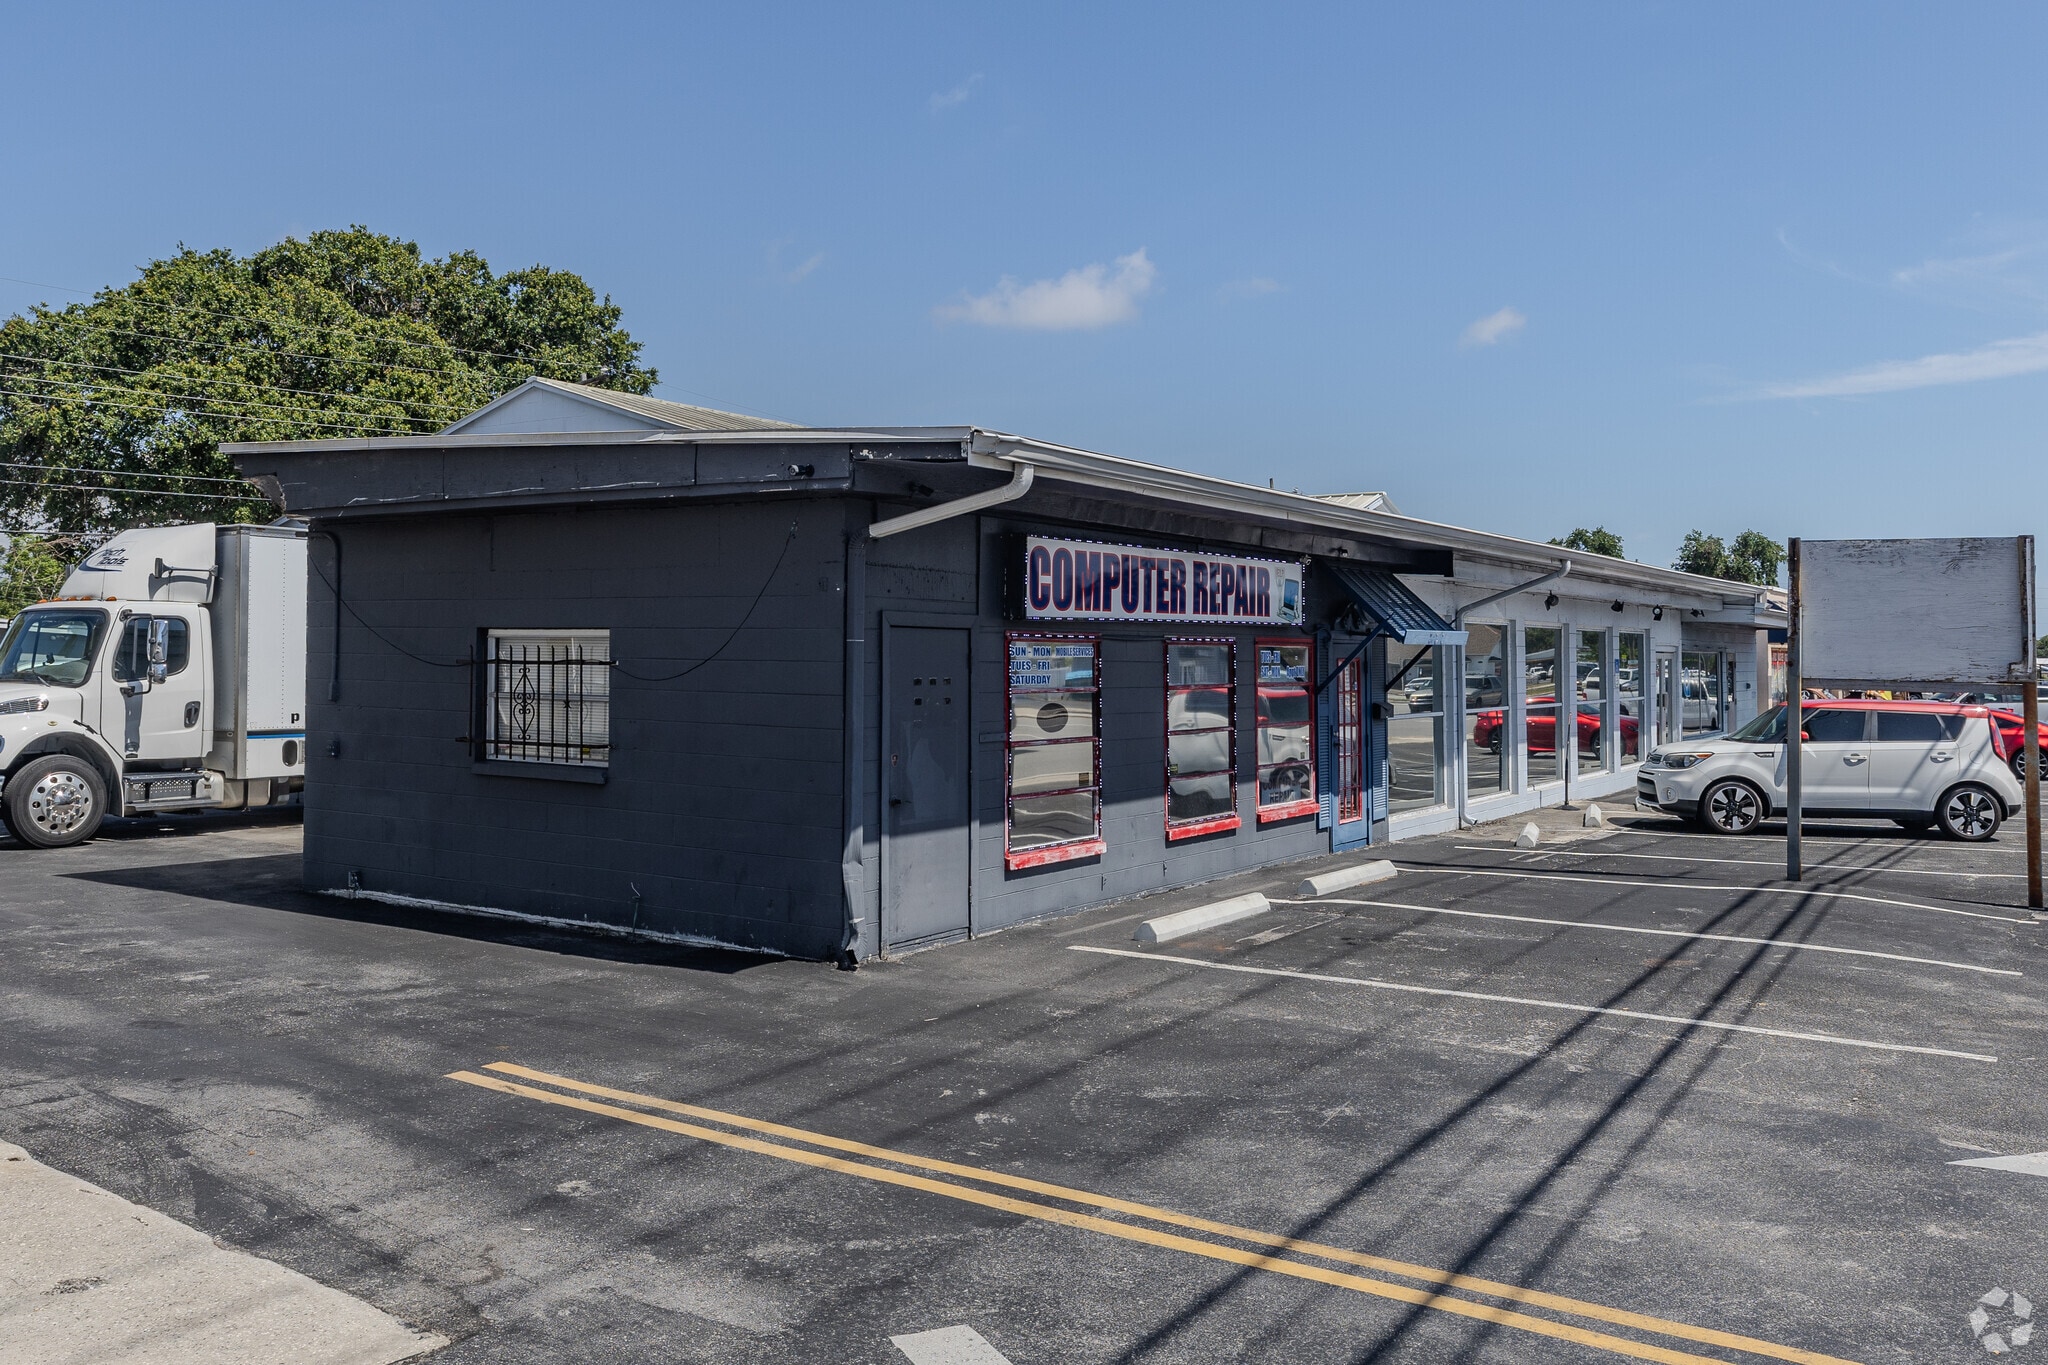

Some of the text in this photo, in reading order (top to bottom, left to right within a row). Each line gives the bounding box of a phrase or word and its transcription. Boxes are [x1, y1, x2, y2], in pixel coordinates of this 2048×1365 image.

[1029, 545, 1271, 617] COMPUTER REPAIR
[1010, 646, 1026, 656] SUN
[1033, 646, 1051, 656] MON
[1011, 661, 1031, 671] TUES
[1038, 661, 1050, 671] FRI
[1010, 675, 1051, 685] SATURDAY
